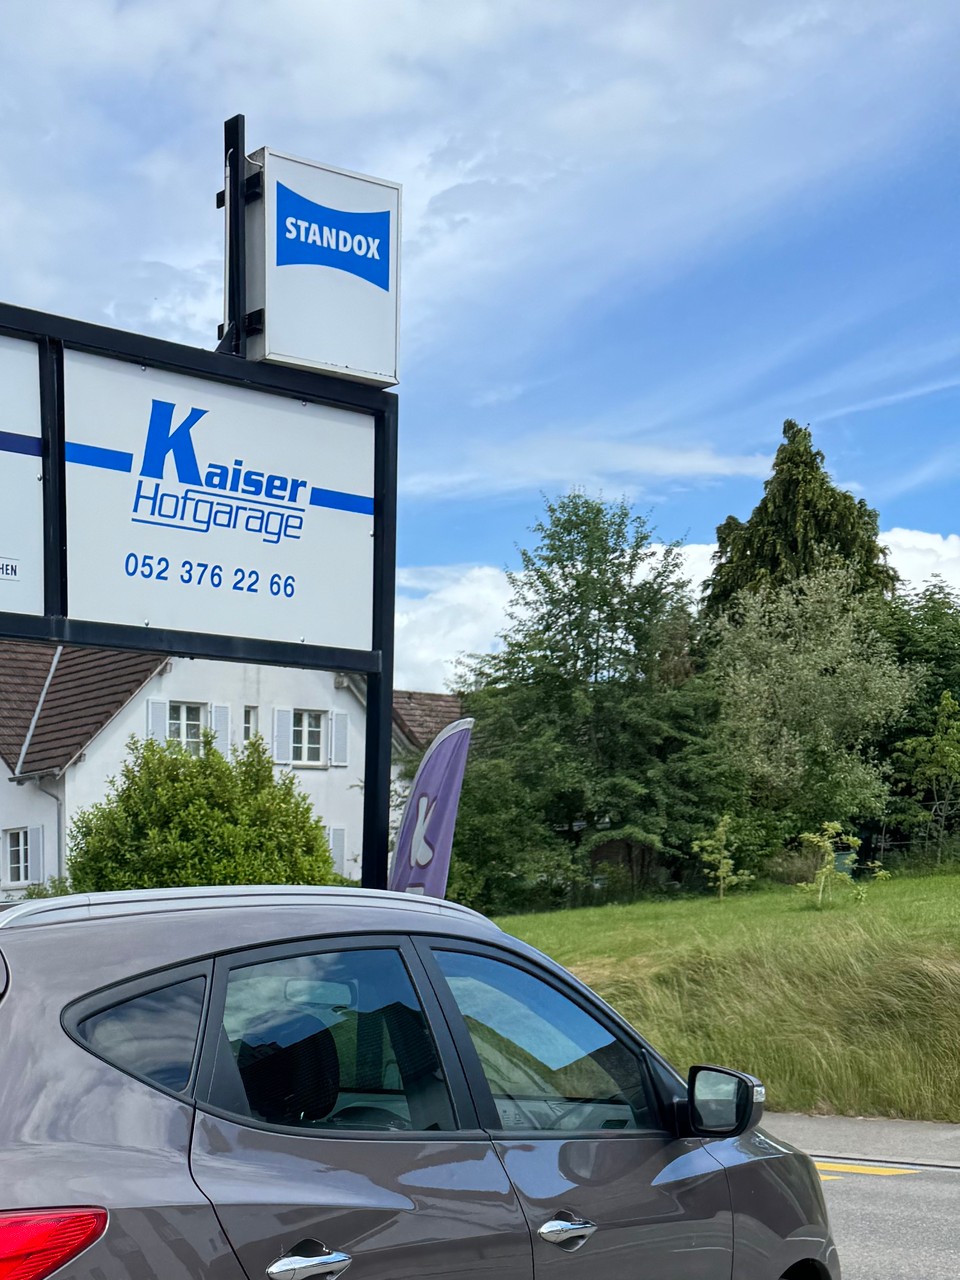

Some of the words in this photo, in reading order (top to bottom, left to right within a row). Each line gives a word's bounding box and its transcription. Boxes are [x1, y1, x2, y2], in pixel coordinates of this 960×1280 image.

[285, 216, 381, 260] STANDOX
[139, 398, 308, 503] Kaiser
[131, 479, 306, 544] Hofgarage
[125, 552, 170, 581] 052
[180, 562, 223, 588] 376
[232, 568, 260, 593] 22
[270, 573, 296, 598] 66
